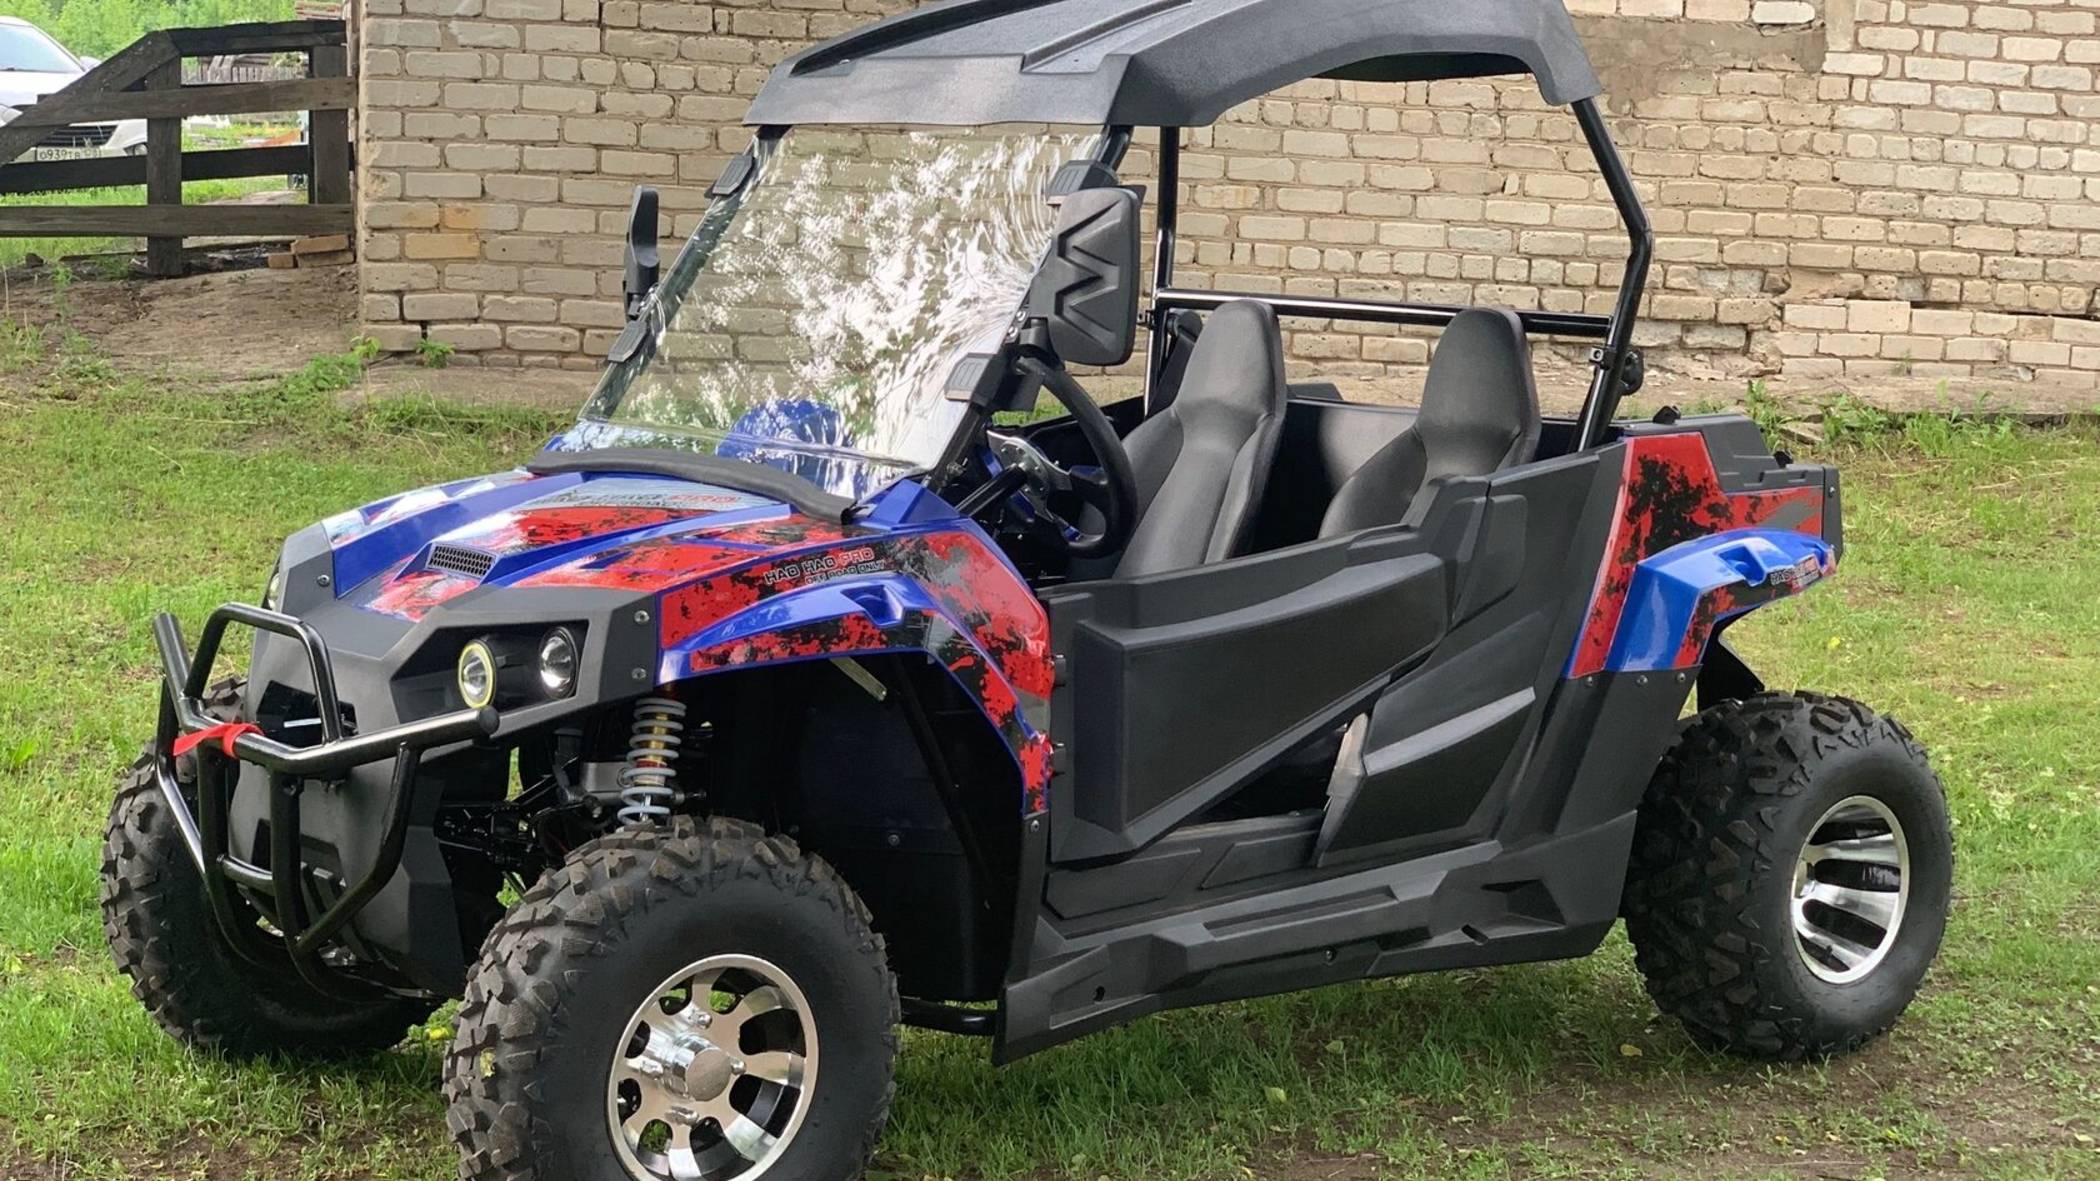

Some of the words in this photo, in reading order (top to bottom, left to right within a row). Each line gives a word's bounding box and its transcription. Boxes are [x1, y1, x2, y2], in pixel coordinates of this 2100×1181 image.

[764, 564, 800, 585] HAO
[802, 556, 837, 575] HAO
[838, 547, 875, 566] PRO
[827, 567, 857, 581] ROAD
